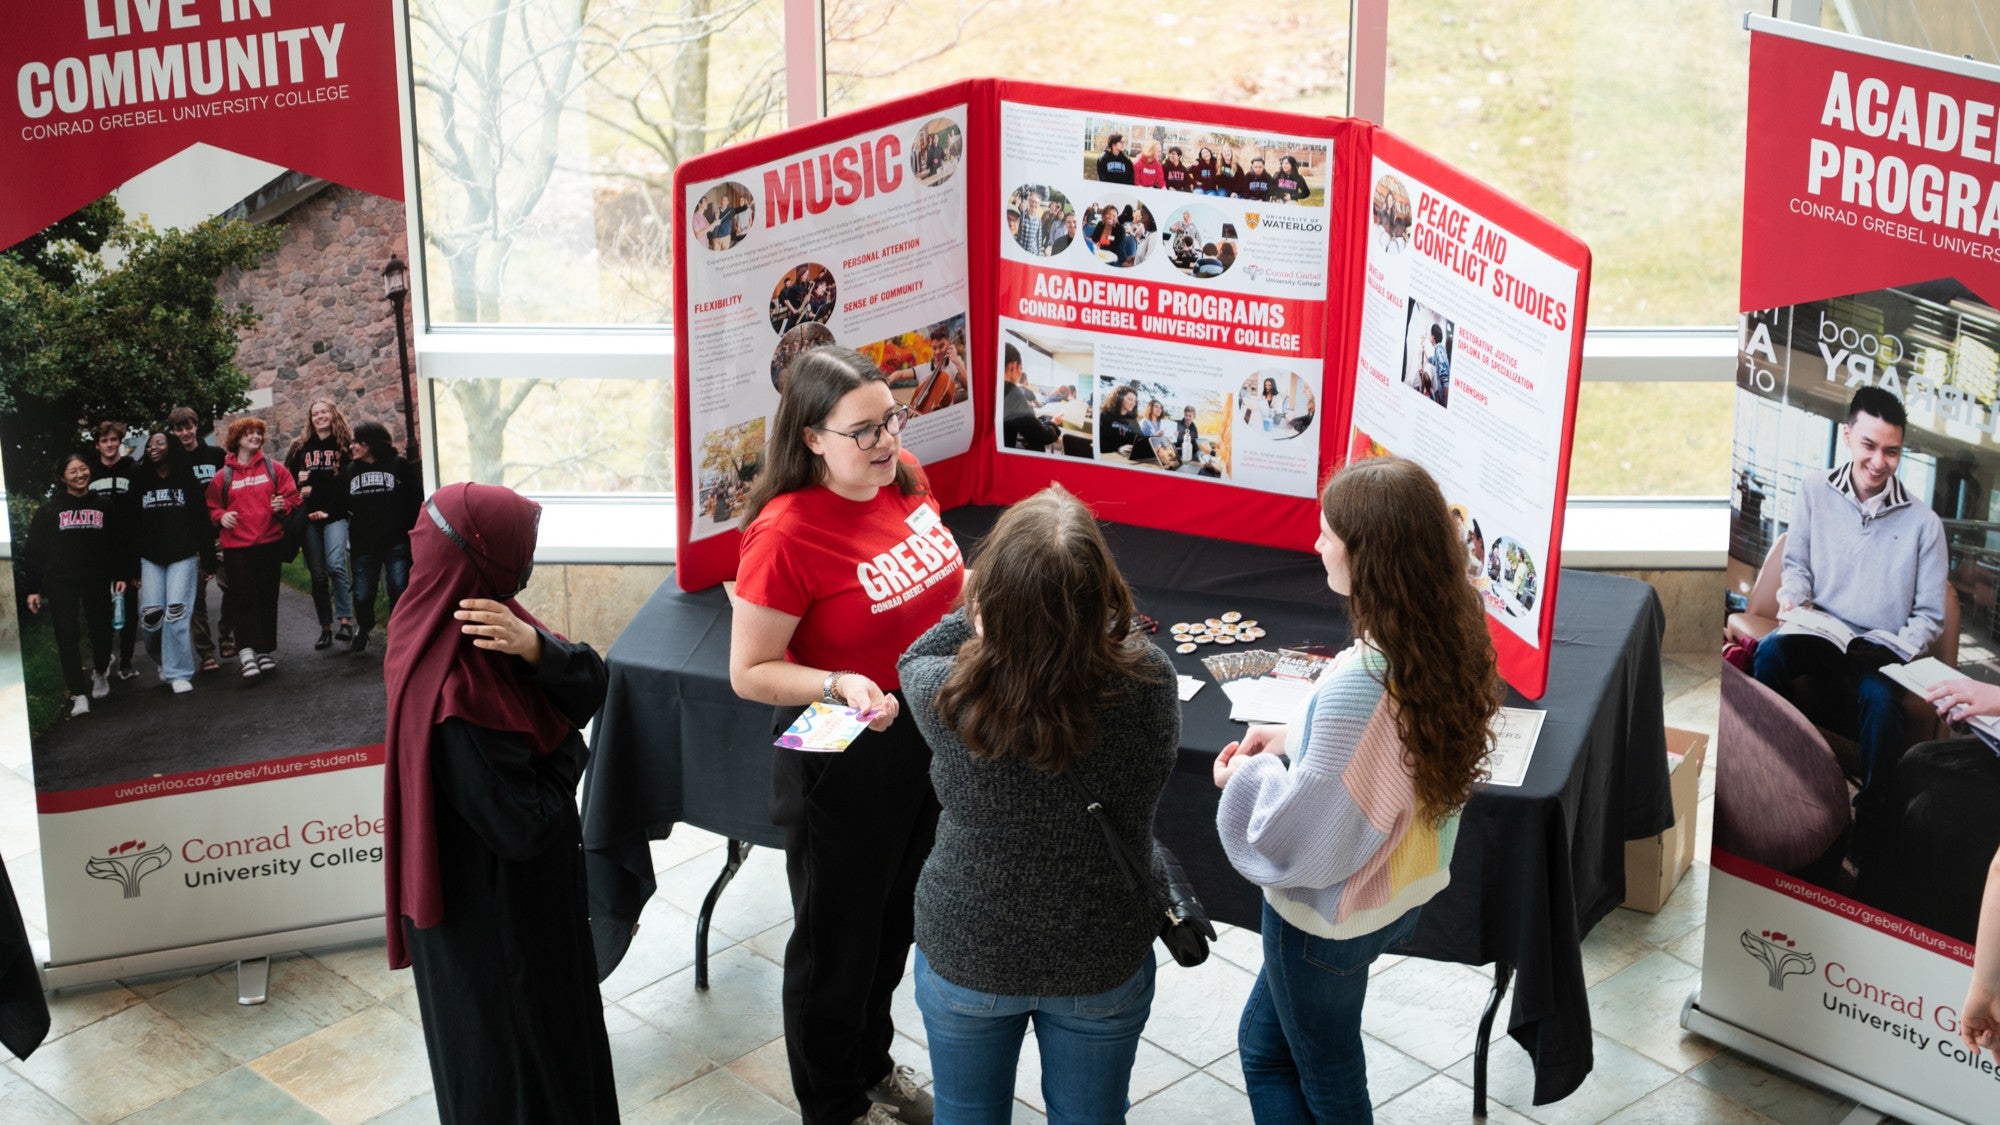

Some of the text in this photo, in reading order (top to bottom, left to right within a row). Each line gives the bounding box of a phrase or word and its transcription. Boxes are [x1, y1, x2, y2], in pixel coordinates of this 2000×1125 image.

[17, 22, 346, 119] COMMUNITY
[21, 84, 350, 141] CONRAD GREBEL UNIVERSITY COLLEGE
[1820, 70, 2000, 166] ACADE
[763, 133, 903, 229] MUSIC
[1262, 219, 1323, 232] WATERLOO
[1417, 191, 1508, 266] PEACE AND
[1790, 197, 1858, 226] CONRAD
[1862, 215, 1928, 245] GREBEL
[842, 238, 921, 270] PERSONAL ATTENTION
[1413, 222, 1489, 288] CONFLICT
[1492, 268, 1567, 332] STUDIES
[694, 294, 743, 314] FLEXIBILITY
[843, 280, 923, 313] SENSE OF COMMUNITY
[1034, 272, 1285, 329] ACADEMIC PROGRAMS
[1018, 297, 1301, 352] CONRAD GREBEL UNIVERSITY COLLEGE
[1458, 326, 1518, 369] RESTORATIVE JUSTICE
[1457, 339, 1481, 360] DIPLOMA
[1491, 359, 1535, 392] SPECIALIZATION
[1454, 377, 1488, 406] INTERNSHIPS
[59, 508, 104, 531] MATH
[870, 595, 903, 615] CONRAD
[114, 751, 368, 799] uwaterloo.ca/grebel/future-students
[181, 814, 385, 863] Conrad Grebe
[184, 847, 384, 888] University Colleg
[1775, 877, 1976, 962] uwaterloo.ca/grebel/future-stu
[1824, 961, 1924, 1021] Conrad
[1823, 992, 1931, 1051] University
